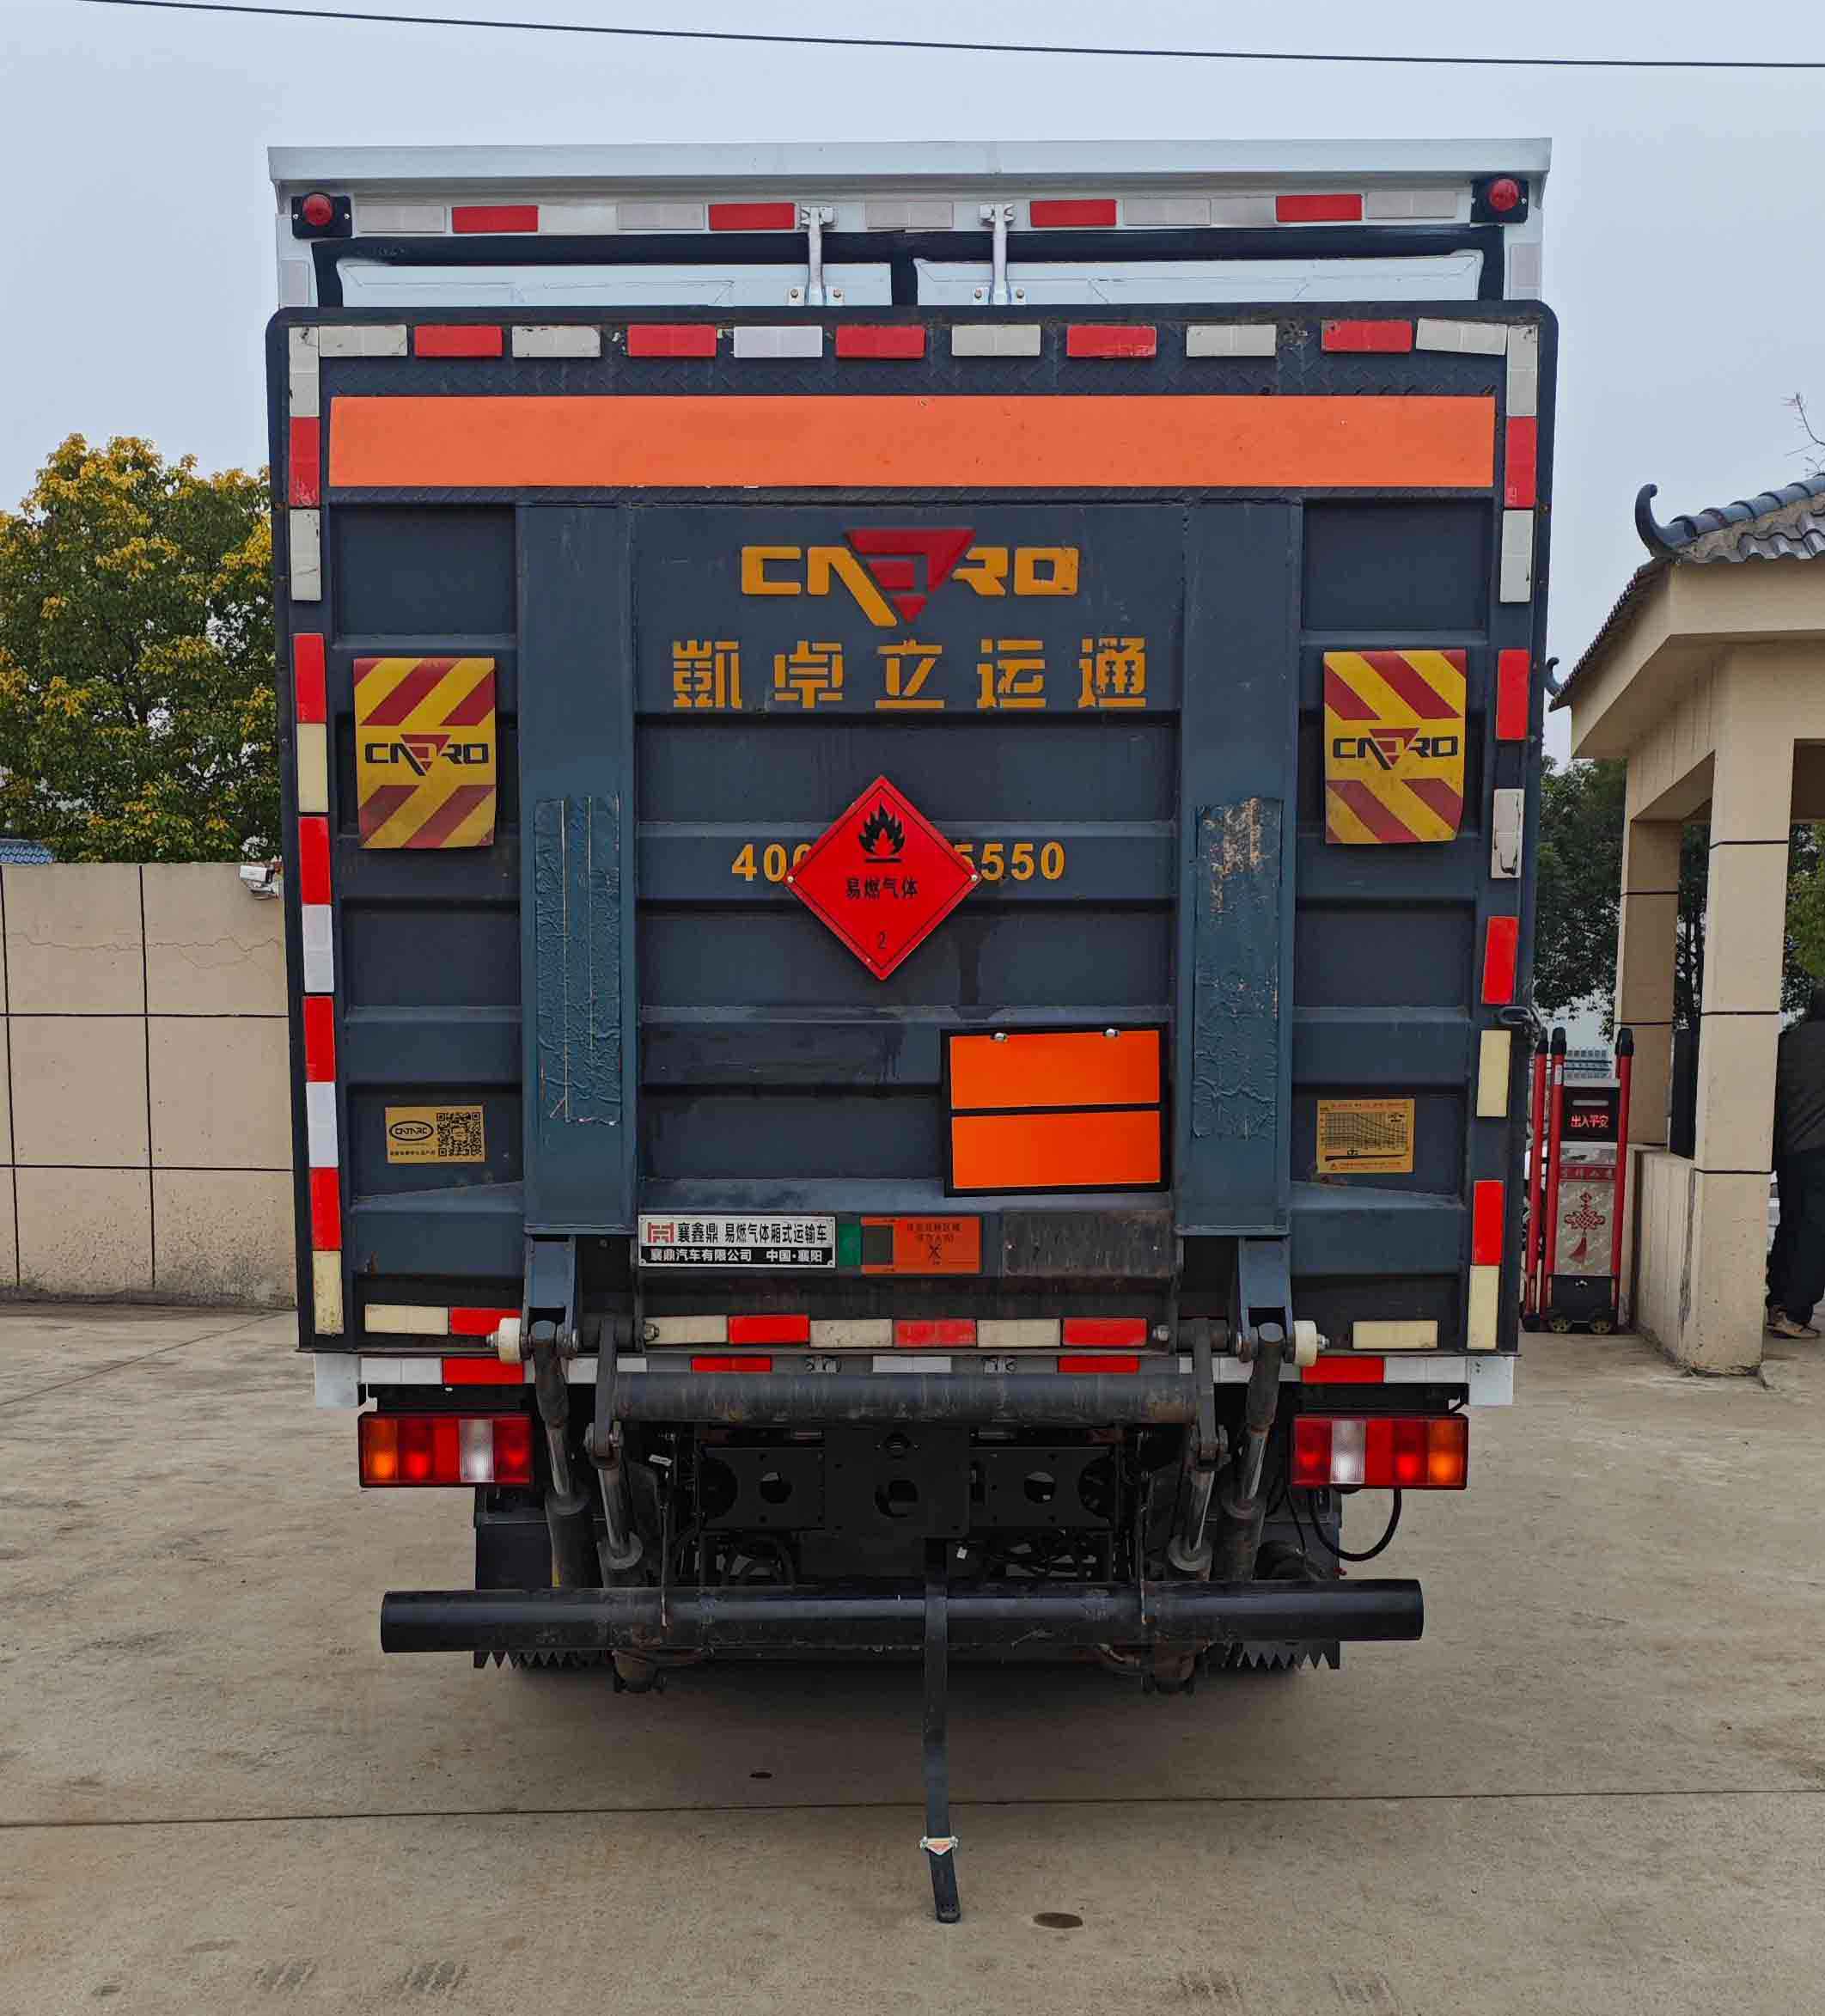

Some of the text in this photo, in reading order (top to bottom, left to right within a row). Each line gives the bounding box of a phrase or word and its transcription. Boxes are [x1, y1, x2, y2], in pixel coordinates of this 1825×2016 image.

[845, 877, 919, 900] 易燃气体
[876, 932, 887, 950] 2
[1571, 1115, 1609, 1128] 出入平安
[725, 1223, 827, 1244] 易燃气体厢式运输车
